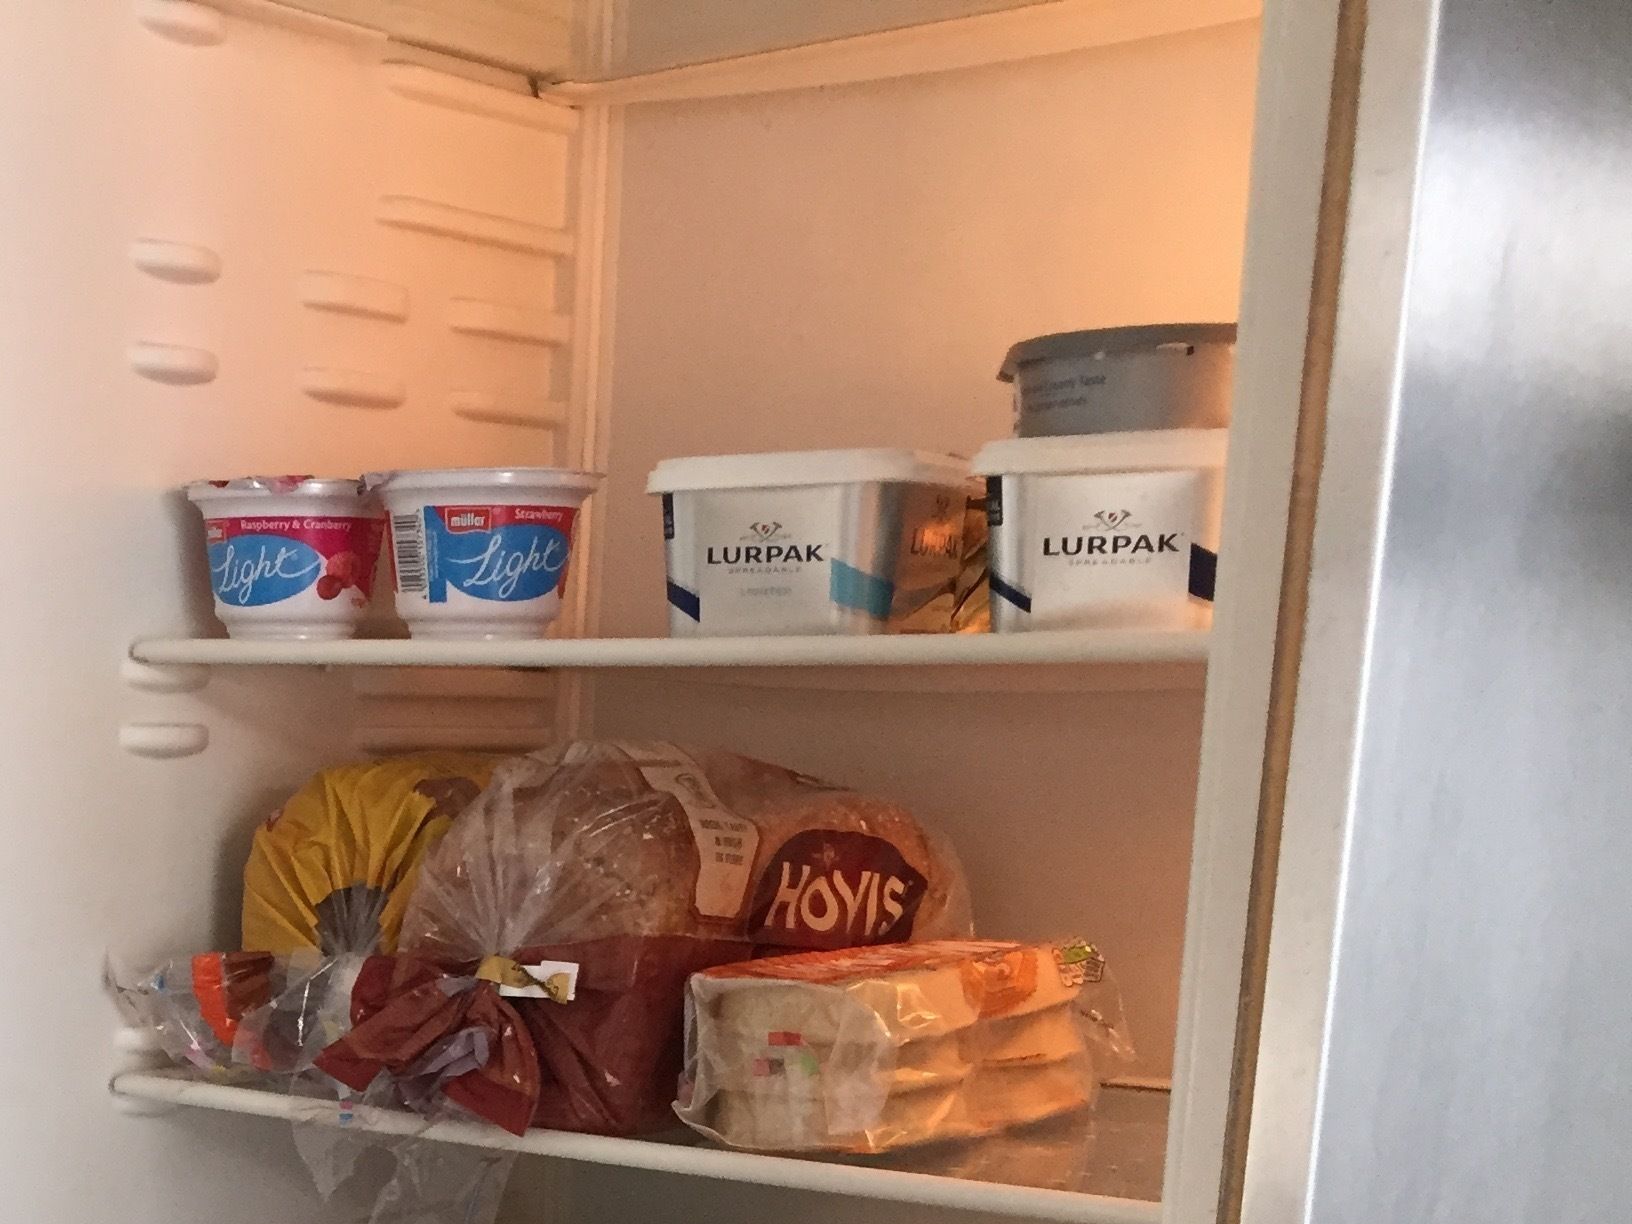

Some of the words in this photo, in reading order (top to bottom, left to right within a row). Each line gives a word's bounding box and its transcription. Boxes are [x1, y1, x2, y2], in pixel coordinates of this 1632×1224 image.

[240, 518, 291, 533] Raspberry
[291, 520, 302, 530] &
[303, 518, 353, 533] Cranberry
[450, 512, 487, 528] müller
[514, 508, 565, 523] Strawberry
[706, 542, 826, 566] LURPAK
[1042, 531, 1182, 556] LURPAK
[212, 543, 320, 606] Light
[448, 533, 572, 600] Light
[763, 860, 907, 937] HOVIS
